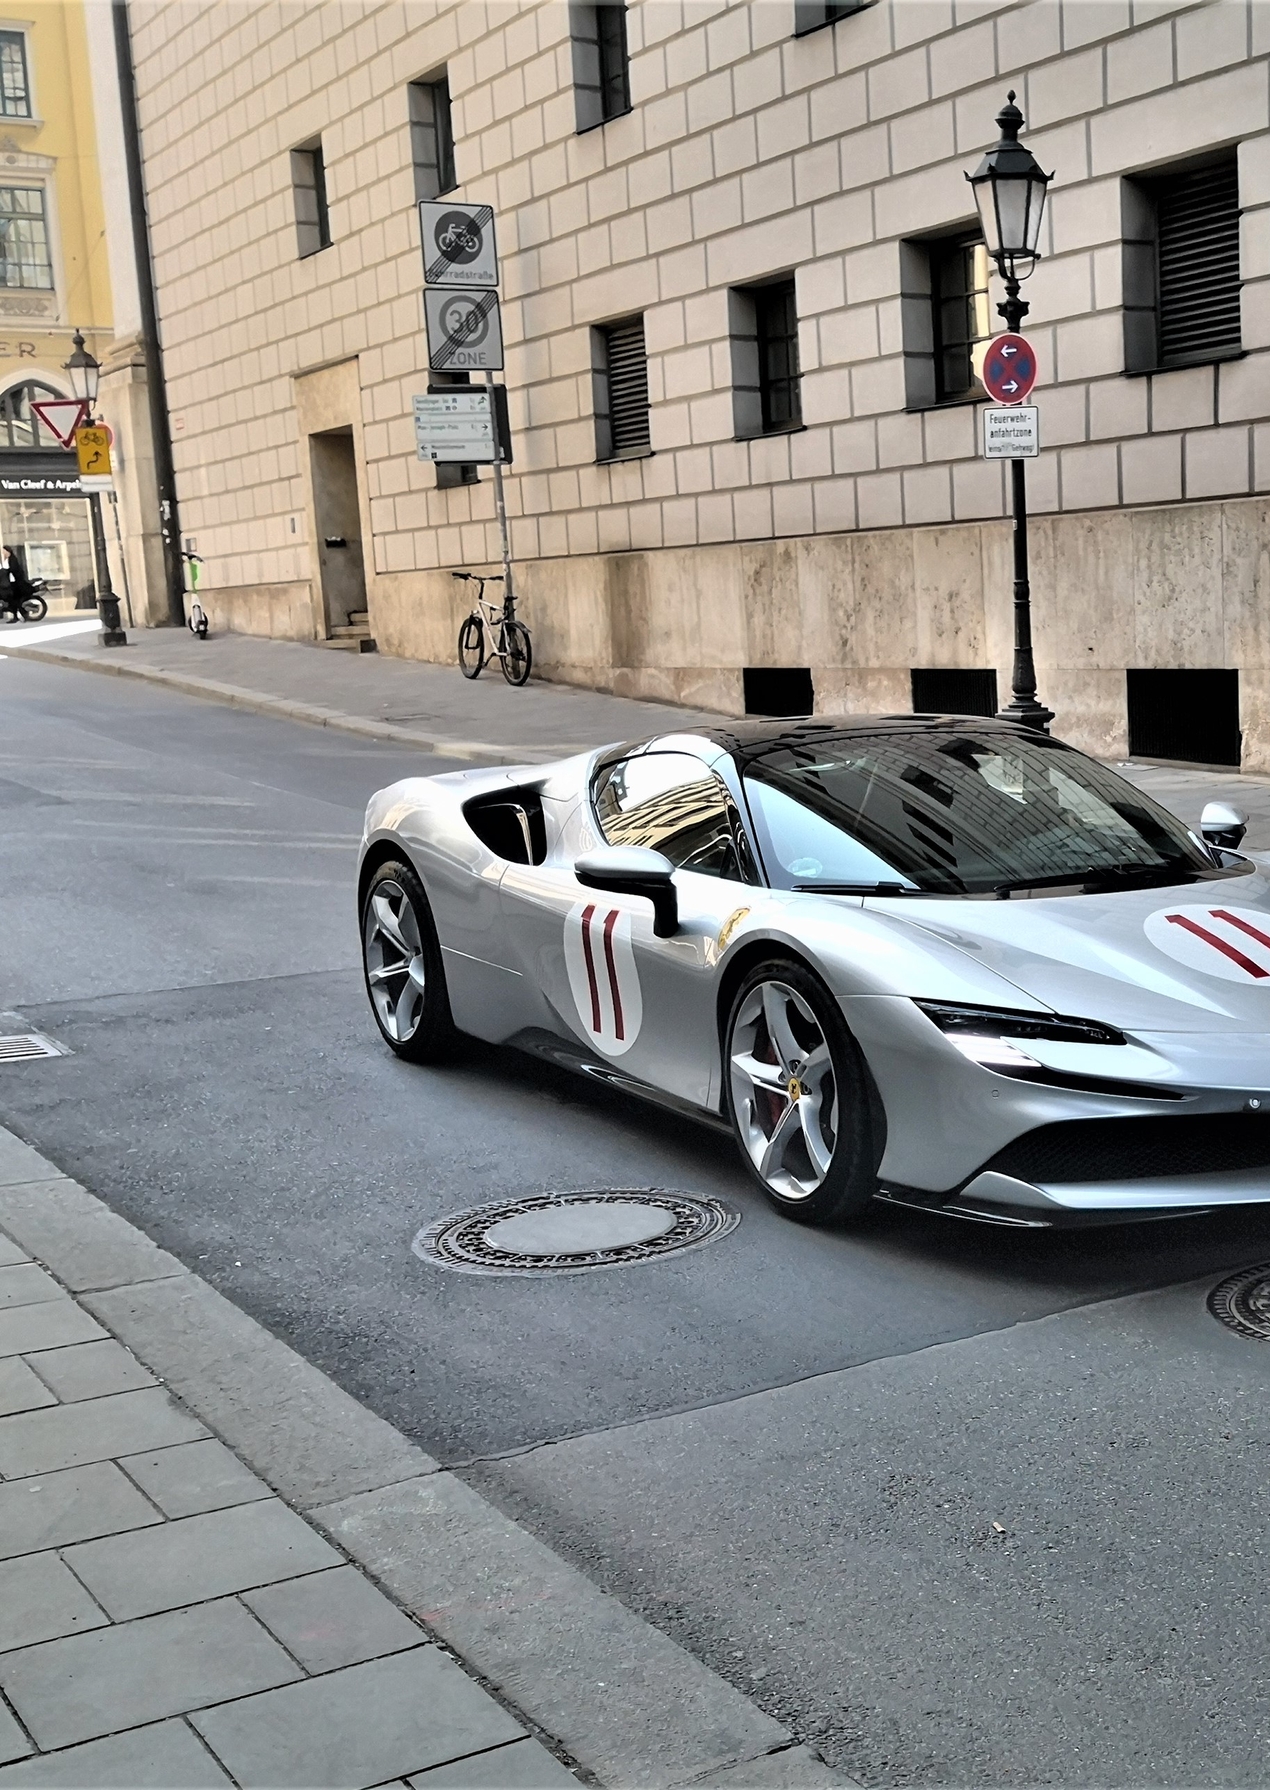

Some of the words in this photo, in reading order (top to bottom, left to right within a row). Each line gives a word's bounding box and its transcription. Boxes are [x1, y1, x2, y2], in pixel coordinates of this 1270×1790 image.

[449, 309, 479, 334] 30
[449, 352, 487, 365] ZONE
[990, 413, 1031, 424] Feuerwehr-
[990, 427, 1032, 438] anfahrtzone
[1, 480, 20, 489] Van
[20, 479, 46, 489] Cleef
